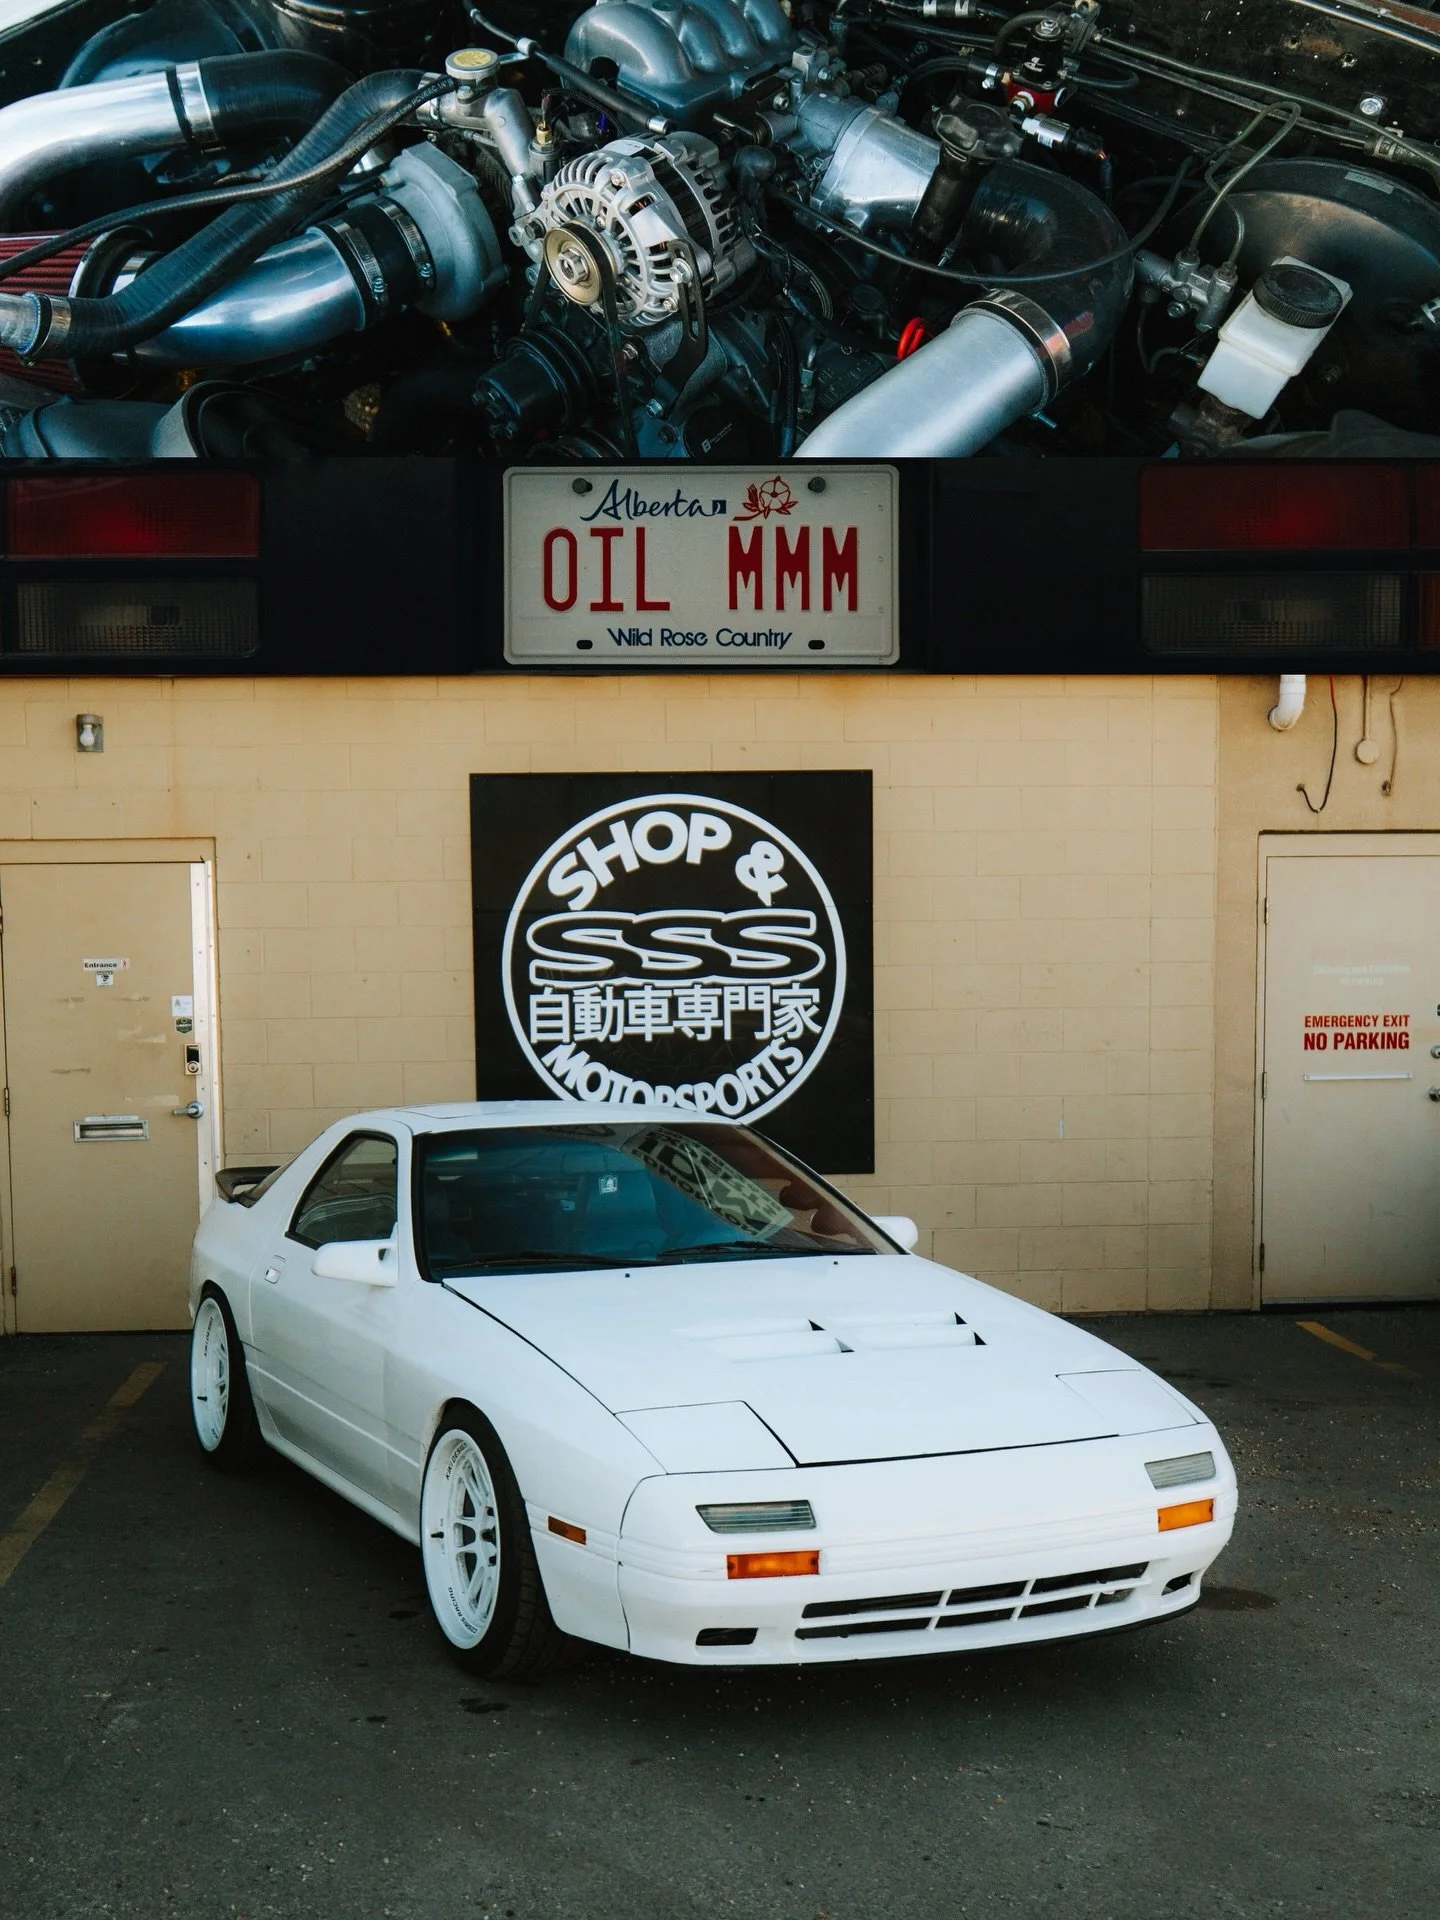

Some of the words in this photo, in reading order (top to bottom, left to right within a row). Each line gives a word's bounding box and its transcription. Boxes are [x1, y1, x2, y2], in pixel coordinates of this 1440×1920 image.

[579, 479, 717, 522] Alberta
[543, 526, 671, 612] OIL
[728, 525, 859, 612] MMM
[607, 628, 653, 647] Wild
[661, 628, 708, 647] Rose
[716, 628, 793, 650] Country
[547, 811, 732, 911] SHOP
[735, 840, 788, 906] &
[526, 909, 826, 985] SSS
[528, 982, 823, 1043] 自動車専門家
[1304, 1015, 1379, 1028] EMERGENCY
[1383, 1015, 1410, 1027] EXIT
[1304, 1033, 1327, 1050] NO
[1333, 1032, 1410, 1050] PARKING
